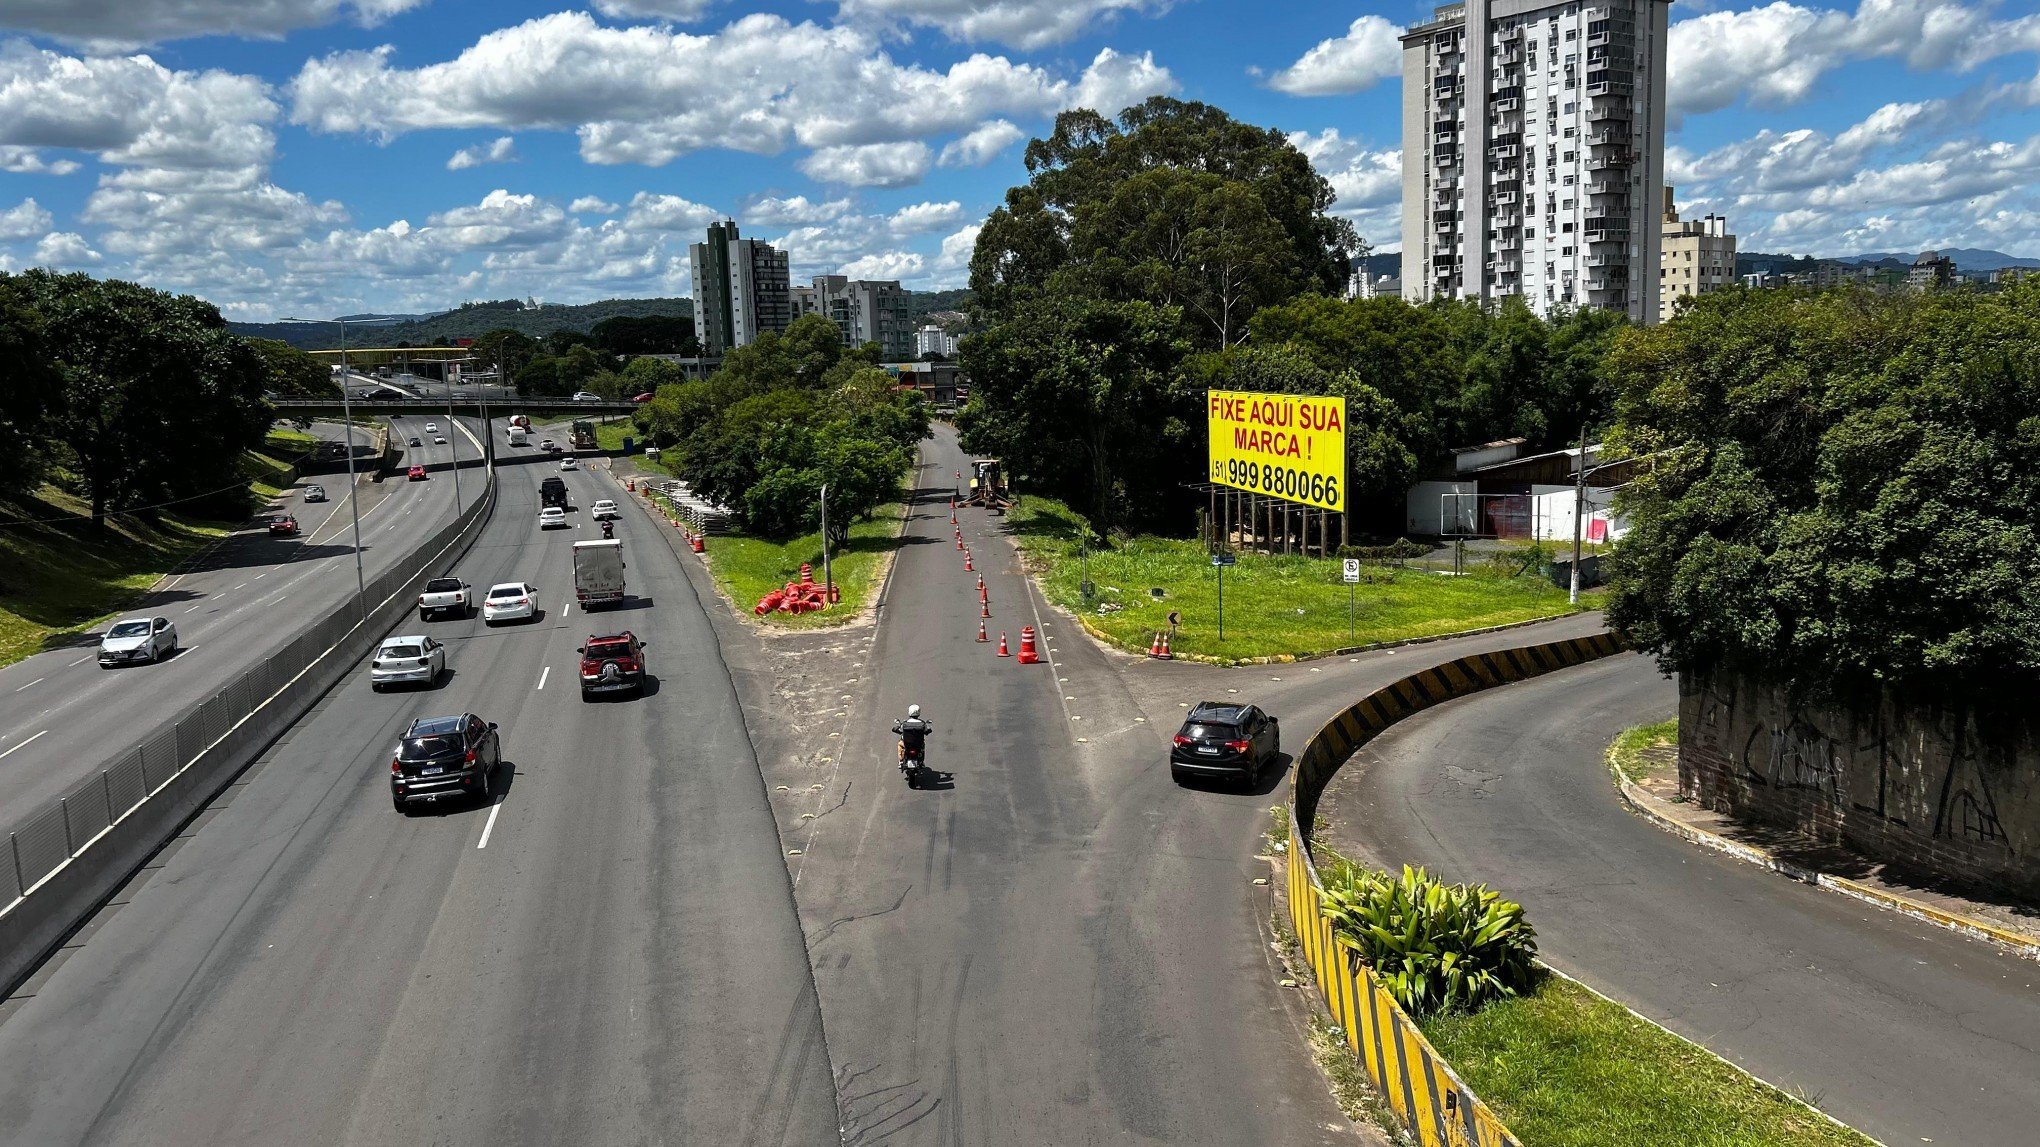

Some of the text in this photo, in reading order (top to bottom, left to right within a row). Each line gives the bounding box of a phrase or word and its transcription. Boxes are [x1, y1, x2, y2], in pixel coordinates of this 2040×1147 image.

[1211, 397, 1342, 432] FIXE AQUI SUA
[1211, 459, 1228, 483] (51)
